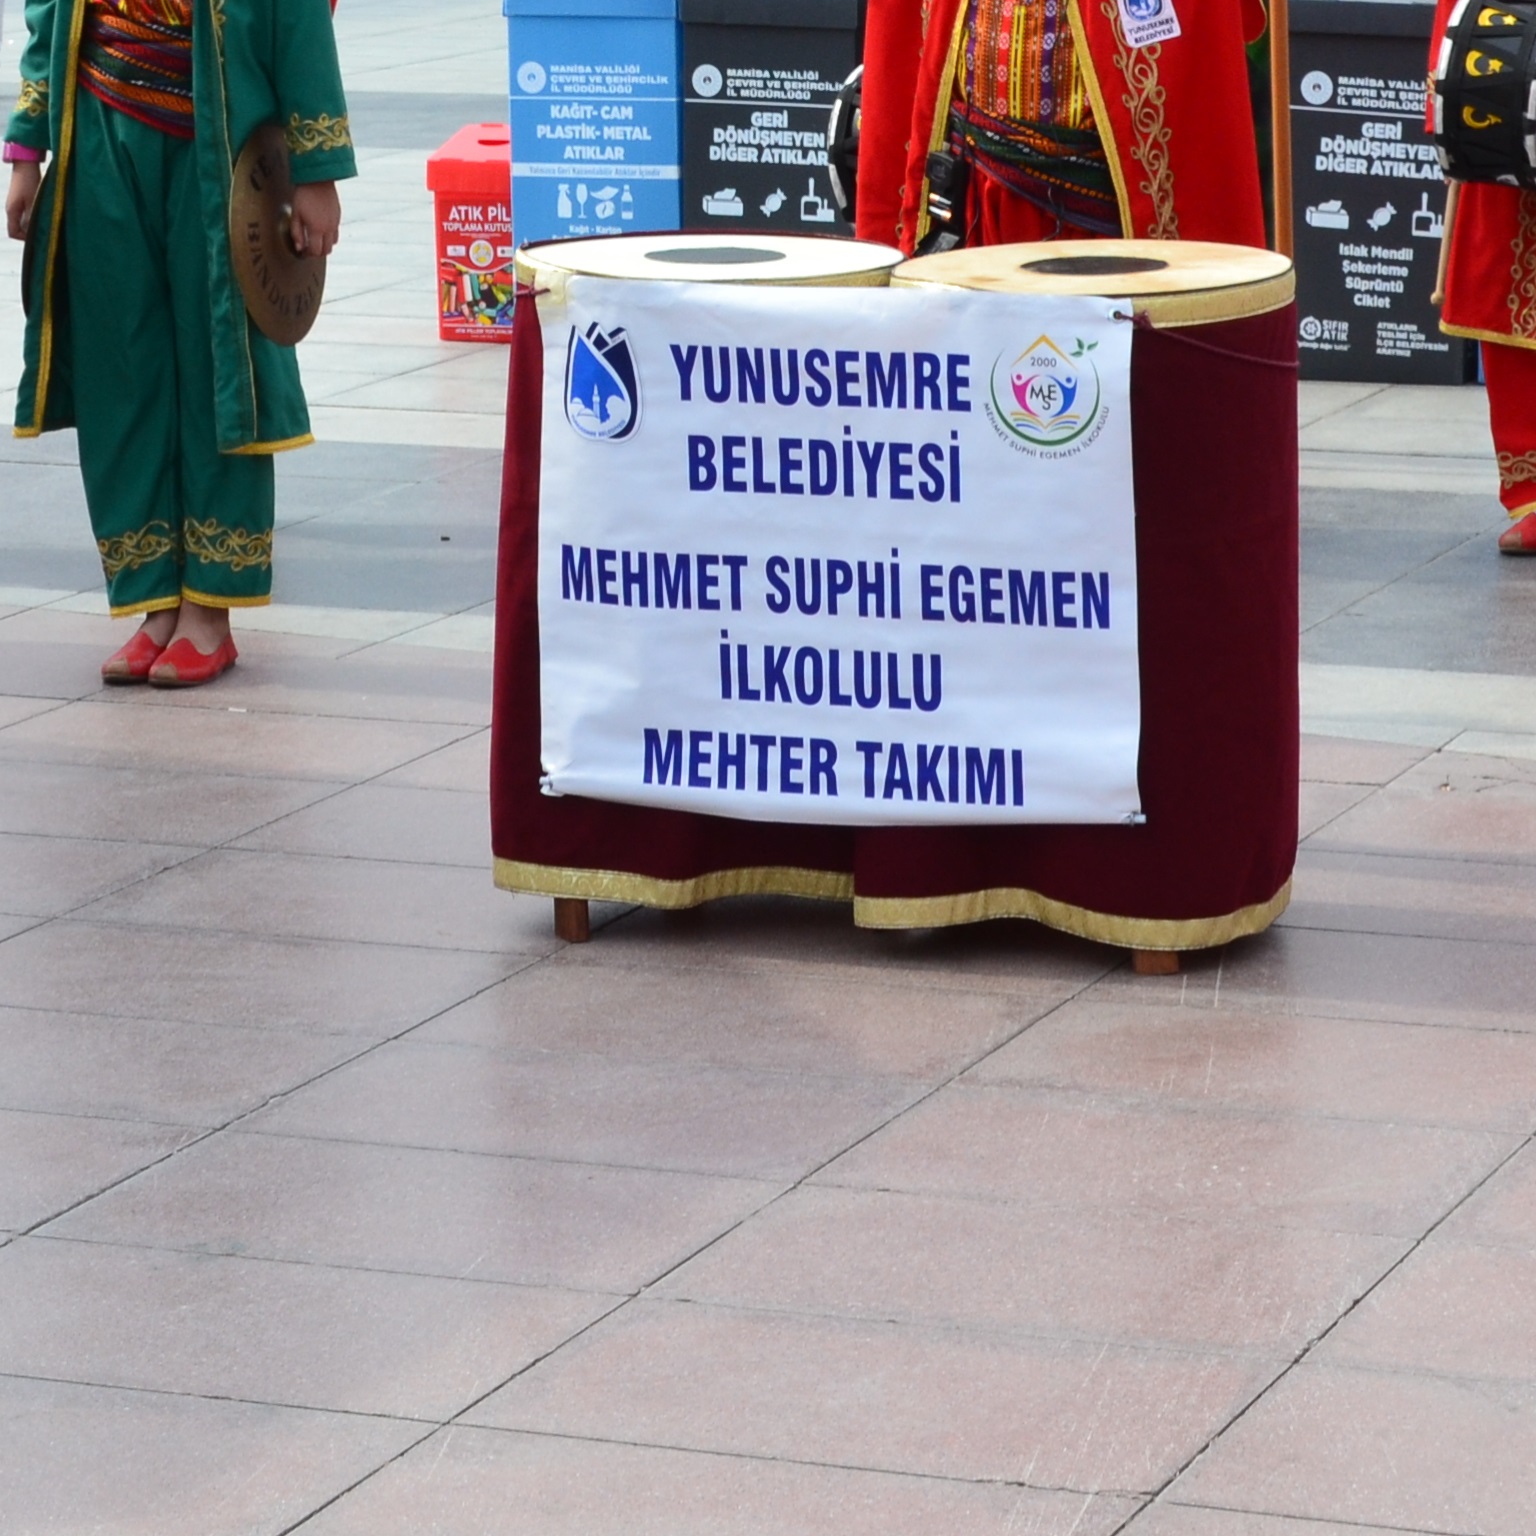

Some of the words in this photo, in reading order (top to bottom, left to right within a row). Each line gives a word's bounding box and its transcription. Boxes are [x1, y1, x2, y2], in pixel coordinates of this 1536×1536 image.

[550, 64, 592, 74] MANİSA
[595, 64, 640, 75] VALİLİĞİ
[726, 68, 771, 79] MANİSA
[773, 69, 819, 80] VALİLİĞİ
[550, 74, 586, 85] ÇEVRE
[588, 75, 603, 83] VE
[726, 78, 764, 90] ÇEVRE
[766, 80, 781, 89] VE
[1338, 76, 1385, 88] MANİSA
[1387, 79, 1428, 91] VALİLİ
[550, 83, 561, 93] İL
[563, 83, 633, 94] MÜDÜRLÜĞÜ
[726, 87, 737, 97] İL
[740, 88, 811, 101] MÜDÜRLÜĞÜ
[1337, 86, 1377, 98] ÇEVRE
[1380, 90, 1396, 99] VE
[1337, 96, 1348, 106] İL
[600, 104, 633, 120] CAM
[750, 109, 789, 129] GERİ
[603, 126, 652, 141] METAL
[713, 125, 825, 148] DÖNÜŞMEYEN
[1361, 121, 1403, 140] GERİ
[563, 145, 625, 161] ATIKLAR
[709, 143, 759, 163] DİĞER
[760, 147, 829, 166] ATIKLAR
[1315, 153, 1368, 176] DİĞER
[449, 205, 483, 222] ATIK
[488, 202, 511, 222] PİL
[442, 221, 483, 233] TOPLAMA
[484, 222, 512, 234] KUTUS
[1371, 246, 1414, 261] Mendil
[1342, 260, 1409, 278] Şekerleme
[1345, 277, 1405, 294] Süprüntü
[1353, 293, 1391, 309] Ciklet
[1322, 319, 1349, 332] SIFIR
[1322, 330, 1348, 342] ATIK
[1030, 356, 1057, 368] 2000
[669, 341, 973, 414] YUNUSEMRE
[983, 402, 1010, 442] MEHMET
[1008, 440, 1037, 457] SUPHİ
[1039, 446, 1081, 460] EGEMEN
[1080, 405, 1110, 449] İLKOKULU
[687, 425, 964, 504] BELEDİYESİ
[560, 543, 749, 613] MEHMET
[765, 546, 902, 621] SUPHİ
[919, 564, 1112, 630] EGEMEN
[718, 628, 944, 714] İLKOLULU
[642, 727, 839, 797] MEHTER
[855, 739, 1026, 808] TAKIMI
